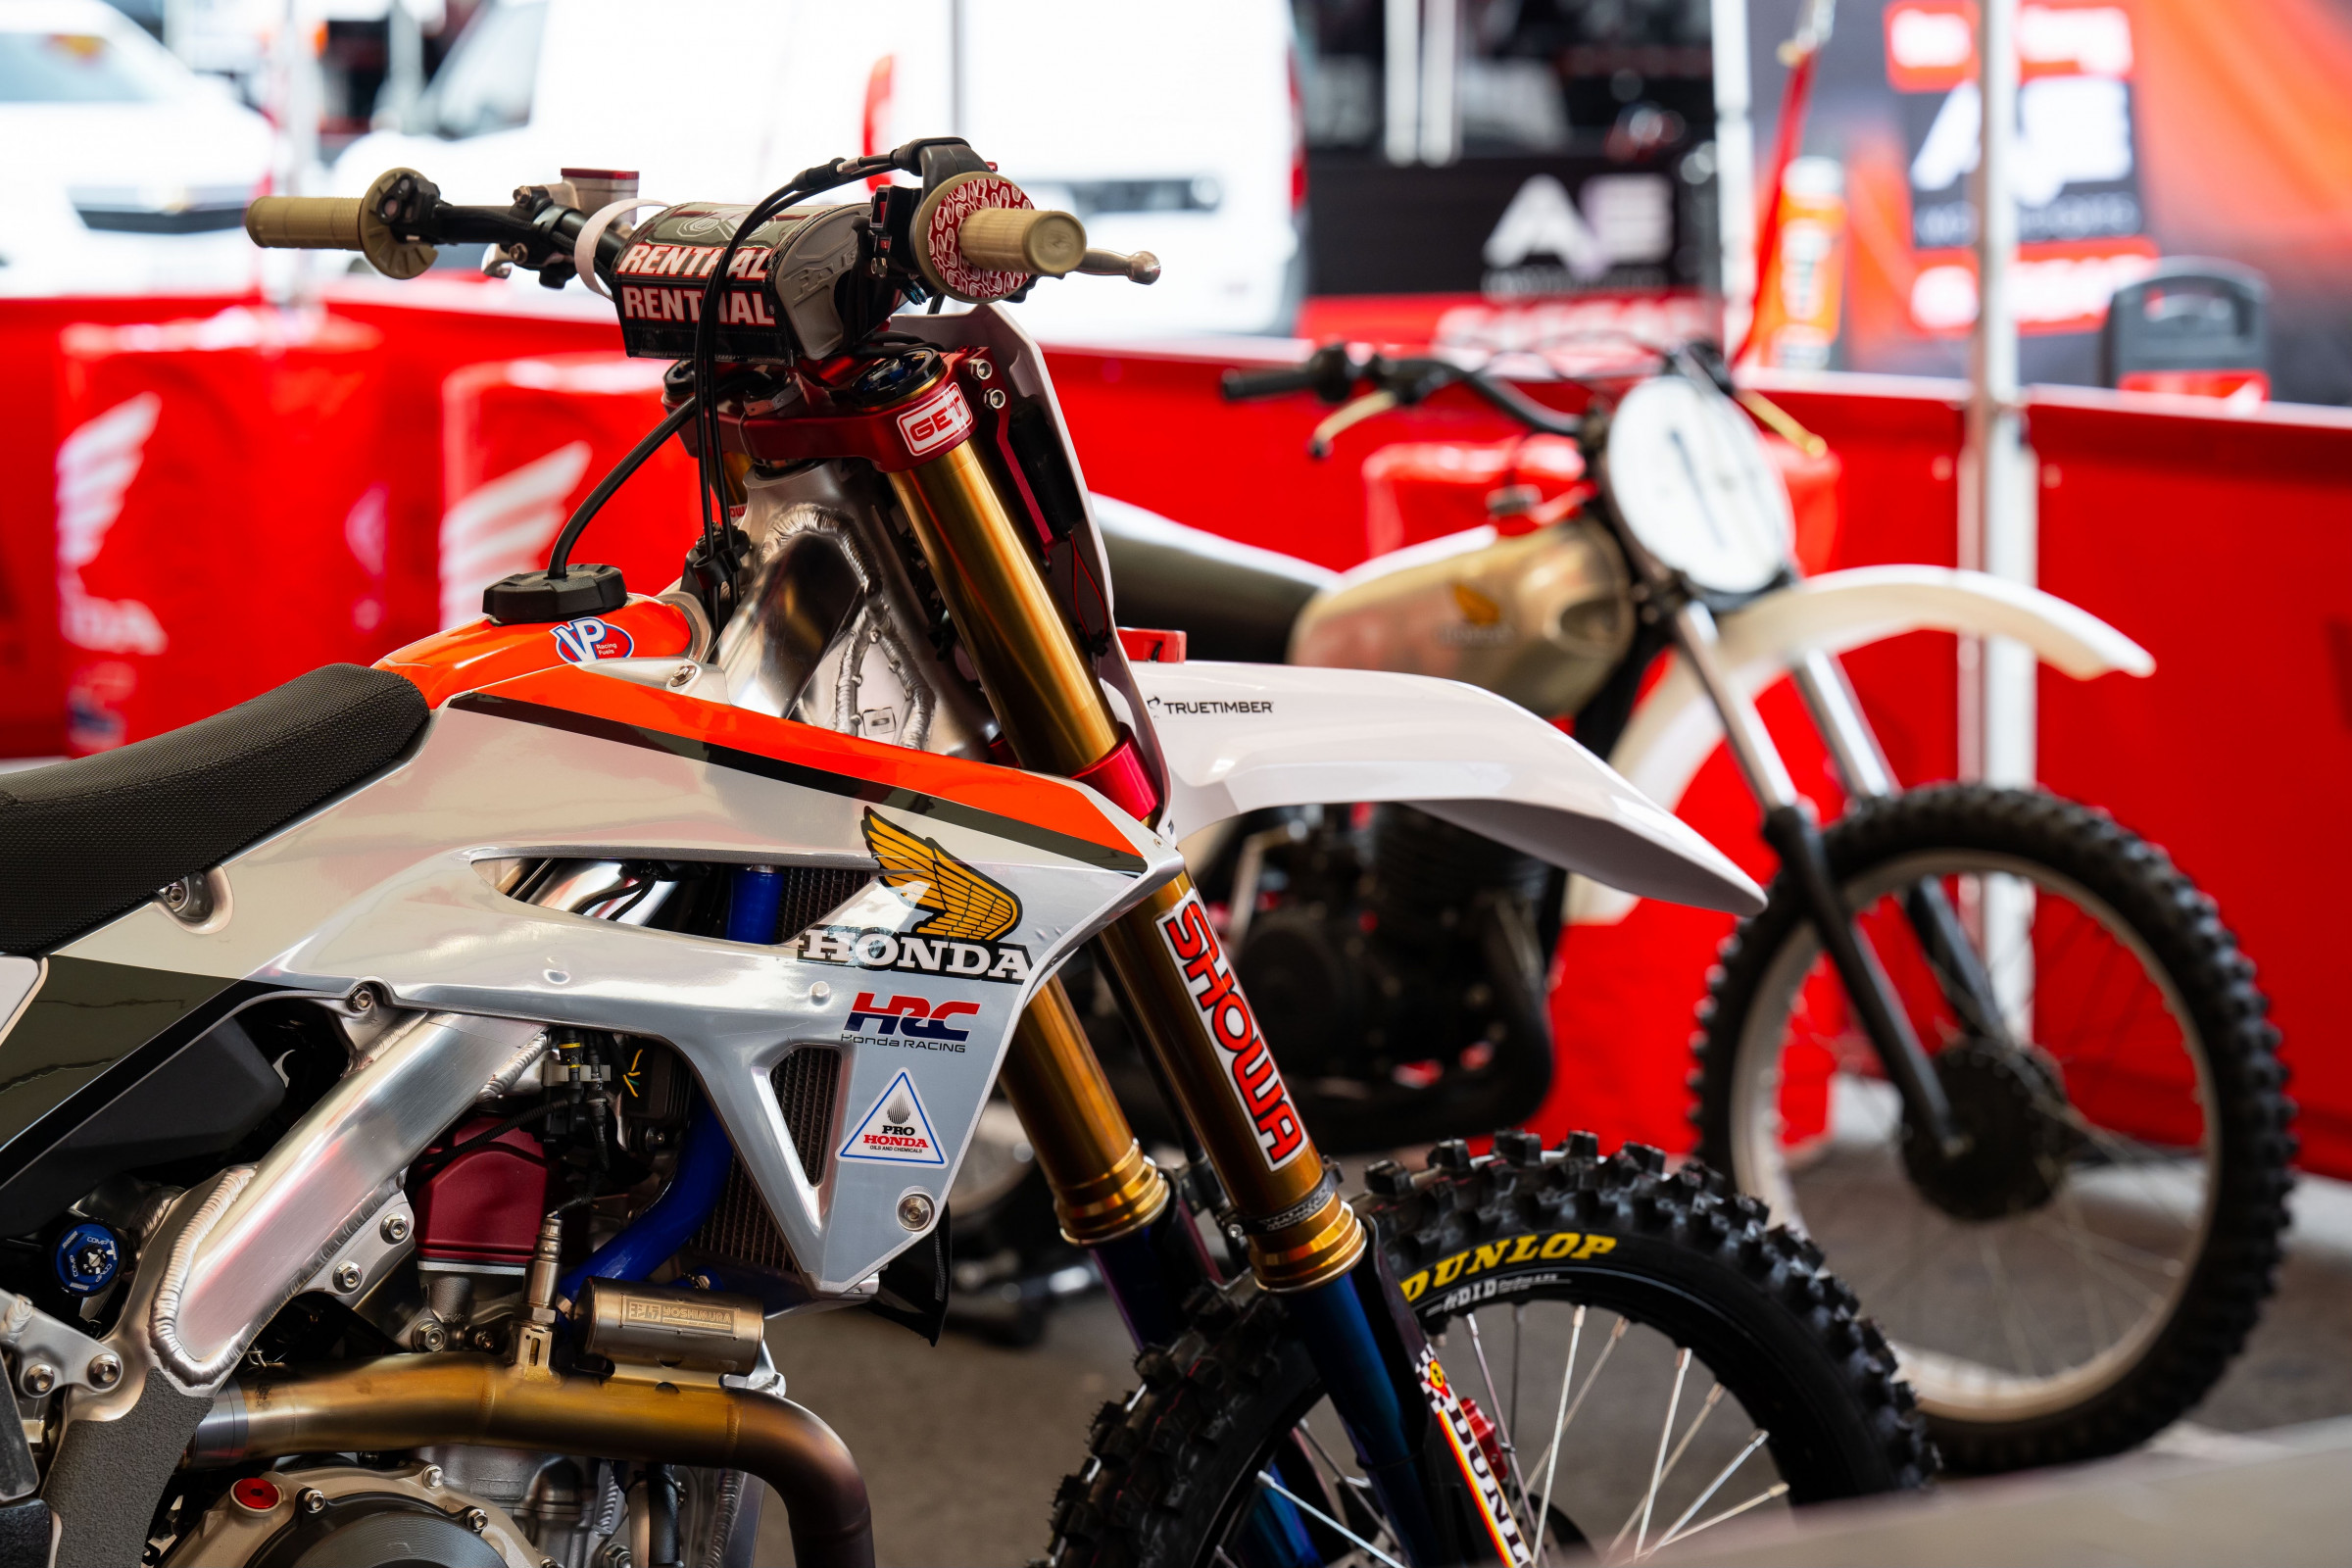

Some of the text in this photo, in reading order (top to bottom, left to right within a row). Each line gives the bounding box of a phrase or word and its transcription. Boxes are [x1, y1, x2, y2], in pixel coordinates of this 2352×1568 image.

[909, 395, 961, 442] GET
[553, 616, 606, 662] VP
[1163, 701, 1273, 714] TRUETIMBER
[801, 929, 1029, 980] HONDA
[843, 992, 981, 1043] HRC
[1162, 900, 1304, 1164] SHOWA
[840, 1032, 966, 1054] Honda RACING
[863, 1135, 928, 1148] HONDA
[882, 1125, 915, 1136] PRO
[1399, 1232, 1618, 1302] DUNLOP
[662, 1304, 732, 1324] YOSHIMURA
[1446, 1406, 1532, 1568] DUNL
